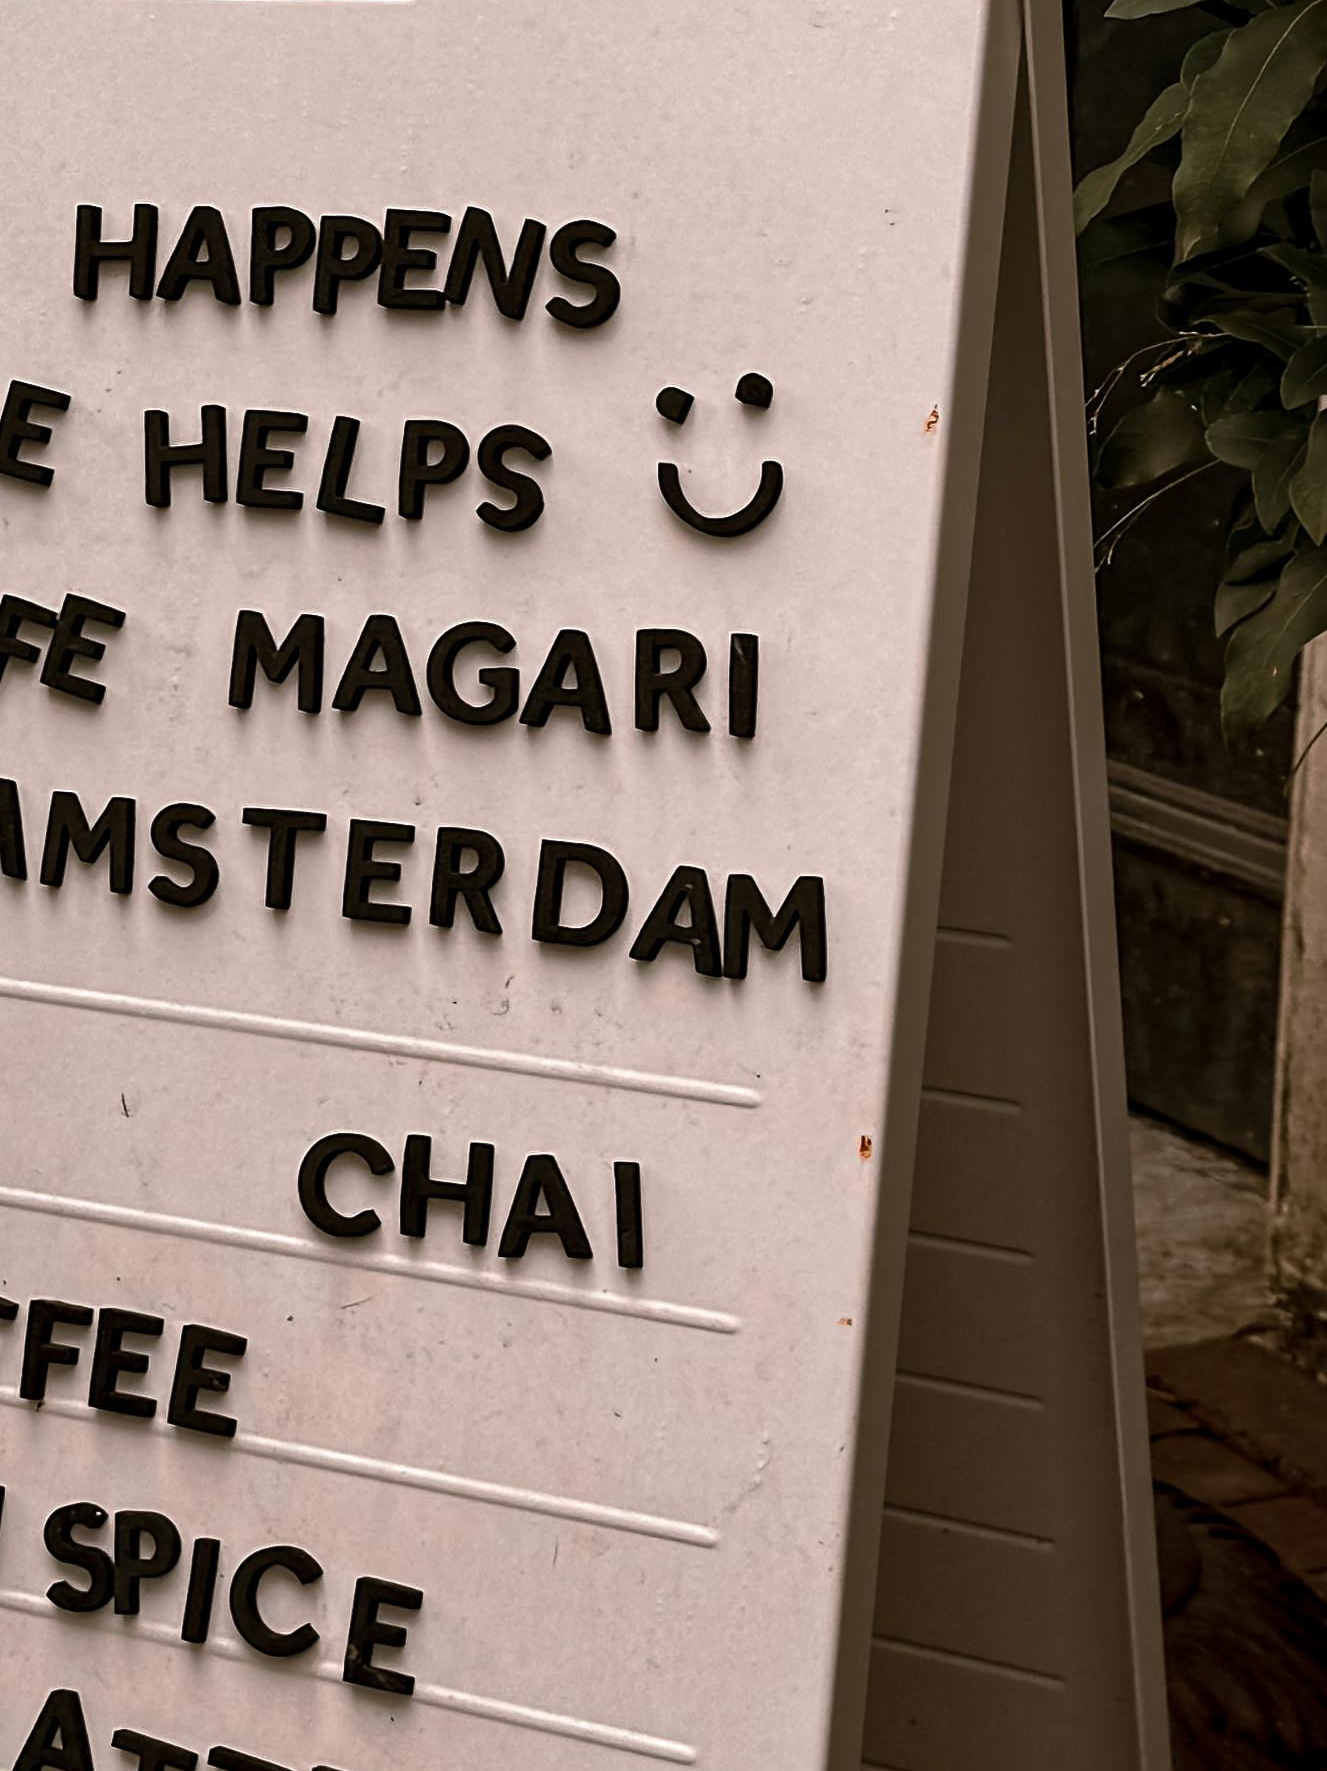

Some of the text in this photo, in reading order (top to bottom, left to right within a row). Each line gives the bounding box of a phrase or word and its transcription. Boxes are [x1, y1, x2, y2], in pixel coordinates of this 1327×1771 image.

[74, 204, 620, 332] HAPPENS
[145, 405, 552, 534] HELPS
[229, 611, 758, 741] MAGARI
[298, 1133, 643, 1269] CHAI
[44, 1503, 423, 1696] SPICE
